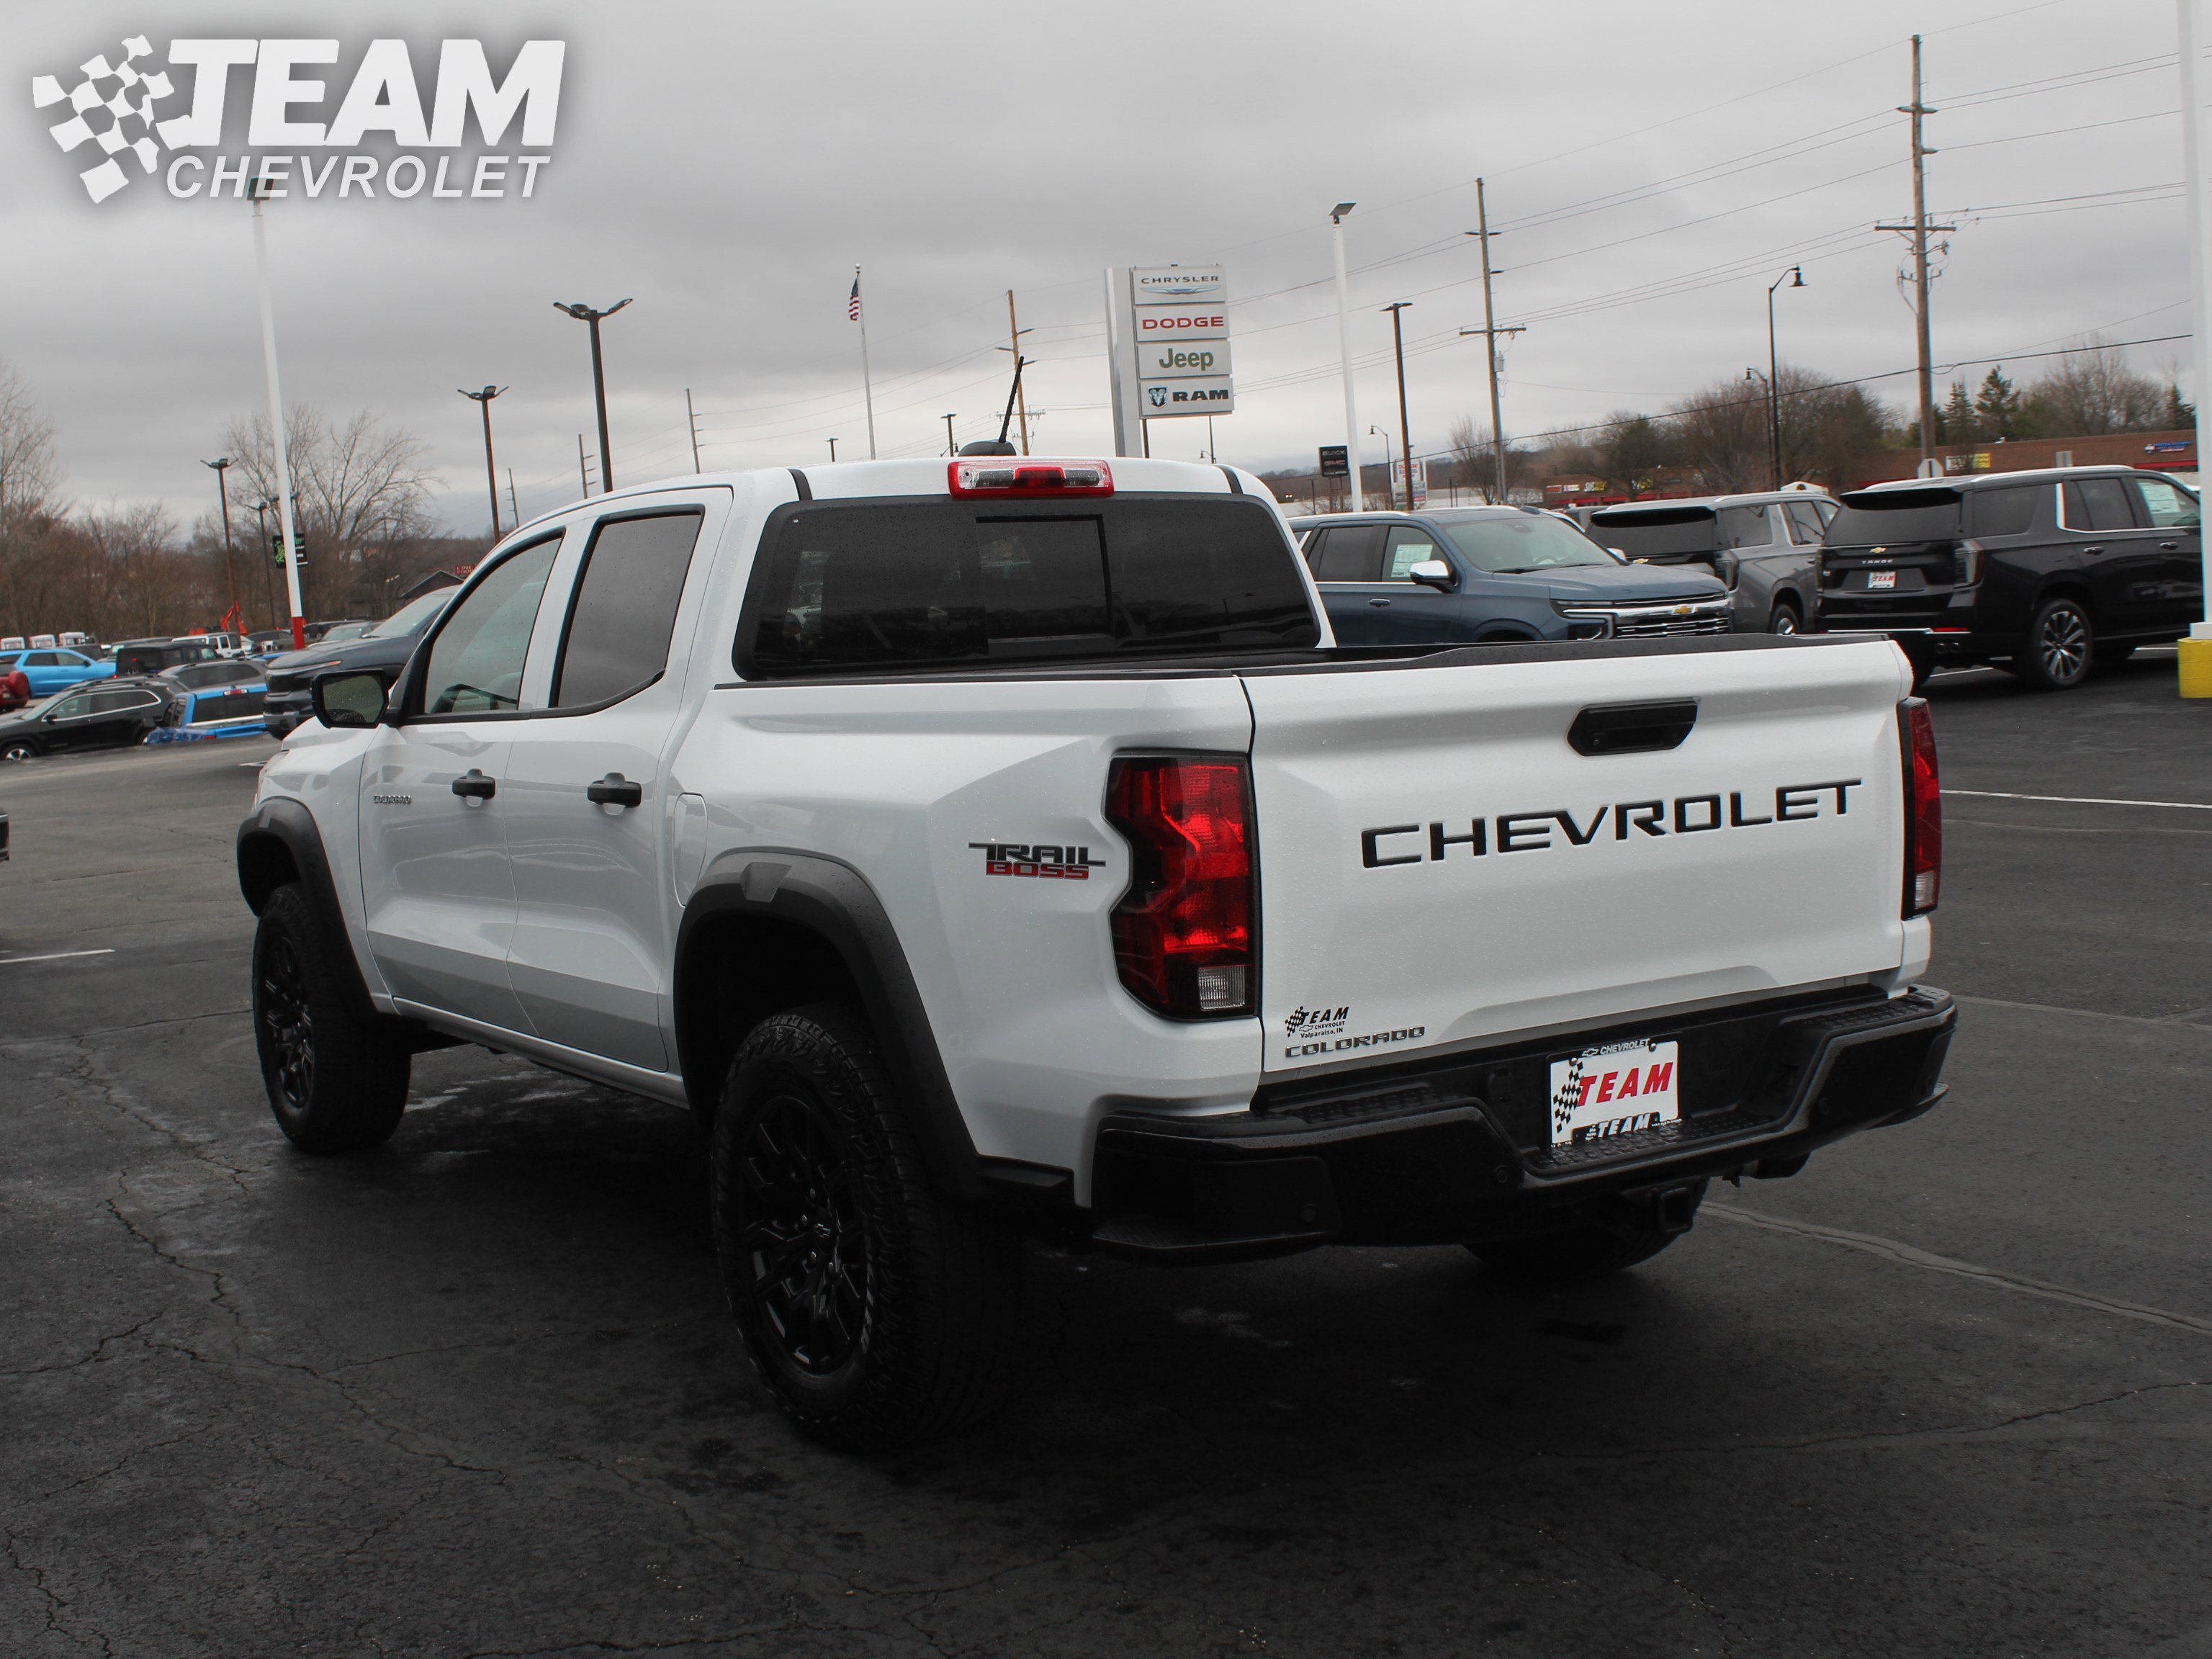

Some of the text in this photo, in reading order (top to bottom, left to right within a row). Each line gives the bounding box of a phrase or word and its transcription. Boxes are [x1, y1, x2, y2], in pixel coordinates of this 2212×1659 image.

[1141, 275, 1219, 284] CHRYSLER
[1142, 316, 1224, 329] DODGE
[1159, 348, 1214, 371] Jeep
[1172, 390, 1229, 402] RAM
[1361, 778, 1863, 869] CHEVROLET
[968, 842, 1107, 867] TRAIL
[986, 860, 1089, 880] BOSS
[1300, 1006, 1349, 1025] TEAM
[1314, 1020, 1345, 1030] CHEVROLET
[1285, 1026, 1425, 1058] COLORADO
[1300, 1029, 1336, 1038] Valparaiso,
[1600, 1038, 1651, 1056] CHEVROLET
[1576, 1062, 1674, 1107] TEAM
[1597, 1113, 1650, 1138] TEAM
